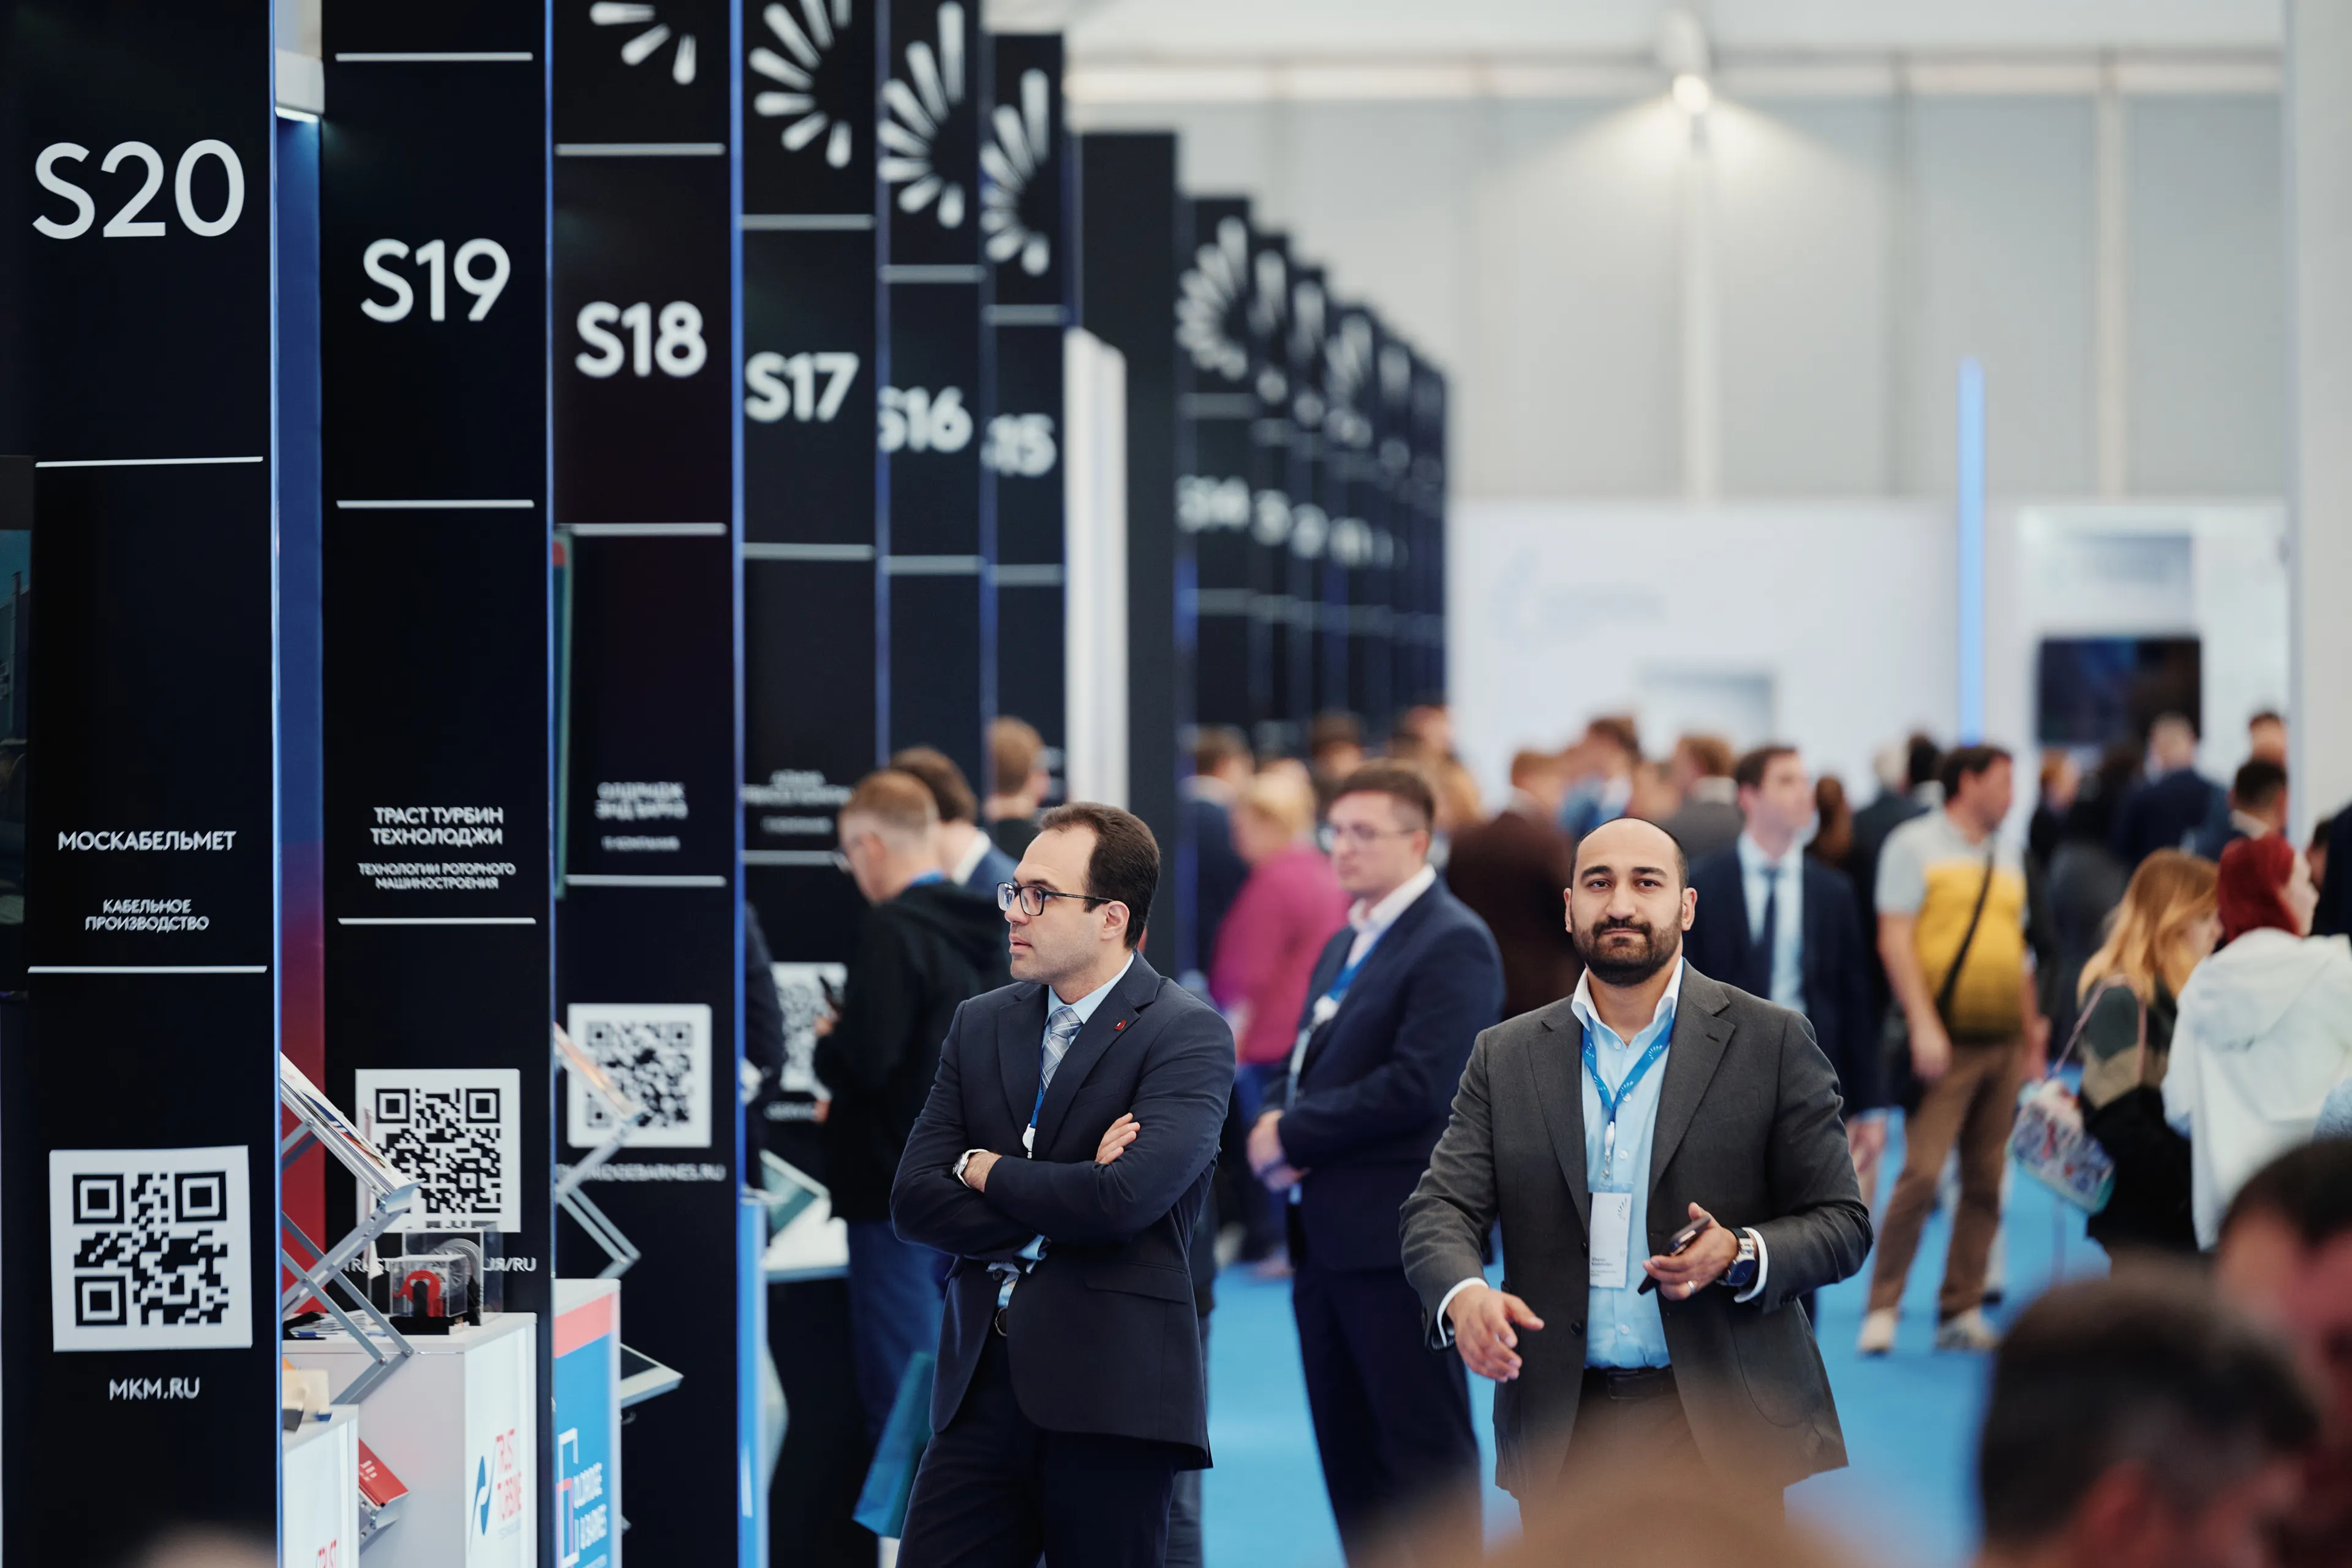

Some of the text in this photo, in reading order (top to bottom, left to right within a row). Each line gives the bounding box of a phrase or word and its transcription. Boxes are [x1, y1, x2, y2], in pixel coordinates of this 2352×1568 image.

[32, 139, 245, 239] S20
[360, 238, 511, 322] S19
[575, 300, 708, 378] S18
[744, 352, 859, 422] S17
[878, 385, 973, 454] S16
[373, 807, 503, 824] ТРАСТ ТУРБИН
[58, 831, 237, 851] МОСКАБЕЛЬМЕТ
[369, 827, 503, 848] ТЕХНОЛОДЖИ
[442, 862, 516, 875] РОТОРНОГО
[103, 899, 192, 914] КАБЕЛЬНОЕ
[85, 916, 209, 933] ПРОИЗВОДСТВО
[109, 1377, 200, 1401] MKM.RU
